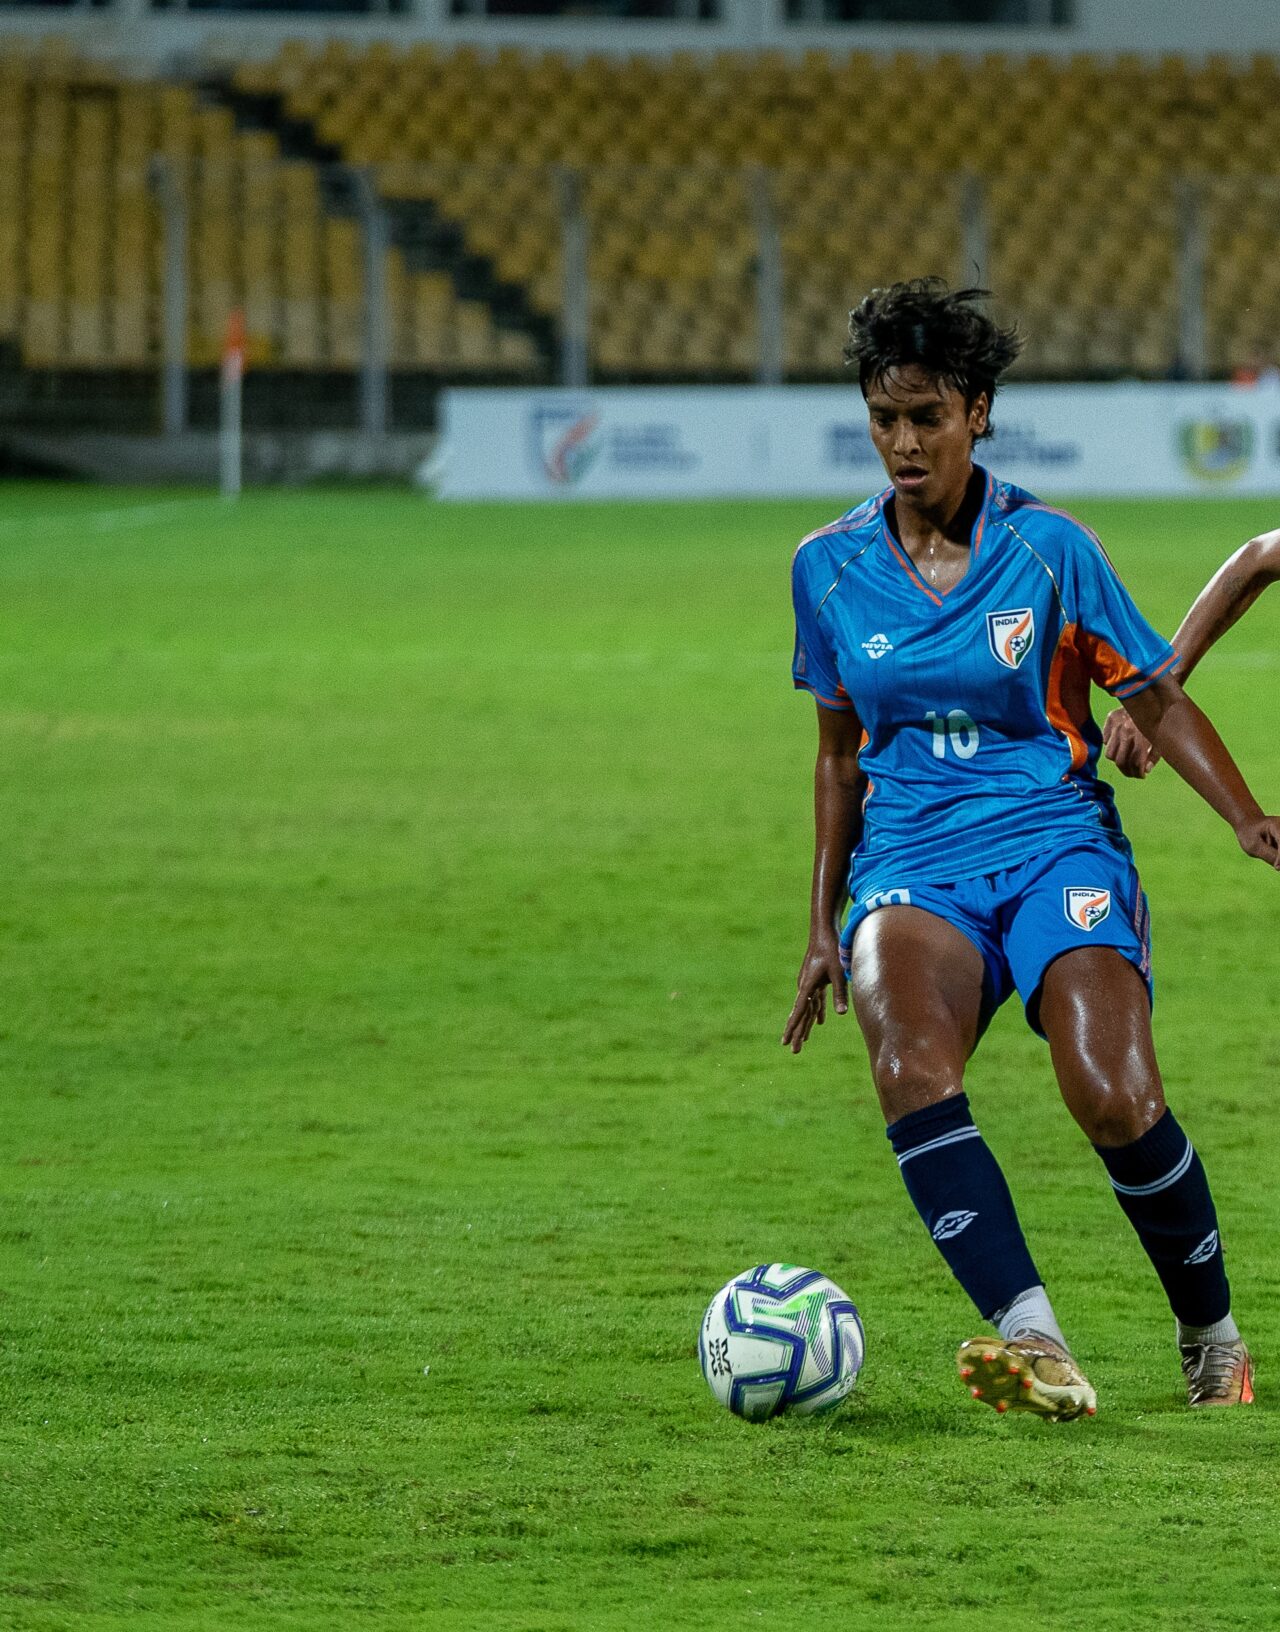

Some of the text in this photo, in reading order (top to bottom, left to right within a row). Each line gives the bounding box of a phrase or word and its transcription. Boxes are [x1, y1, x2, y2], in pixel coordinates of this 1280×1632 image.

[995, 617, 1019, 626] INDIA
[861, 642, 894, 650] NIVIA
[924, 709, 980, 759] 10
[715, 1337, 725, 1377] VECTOR
